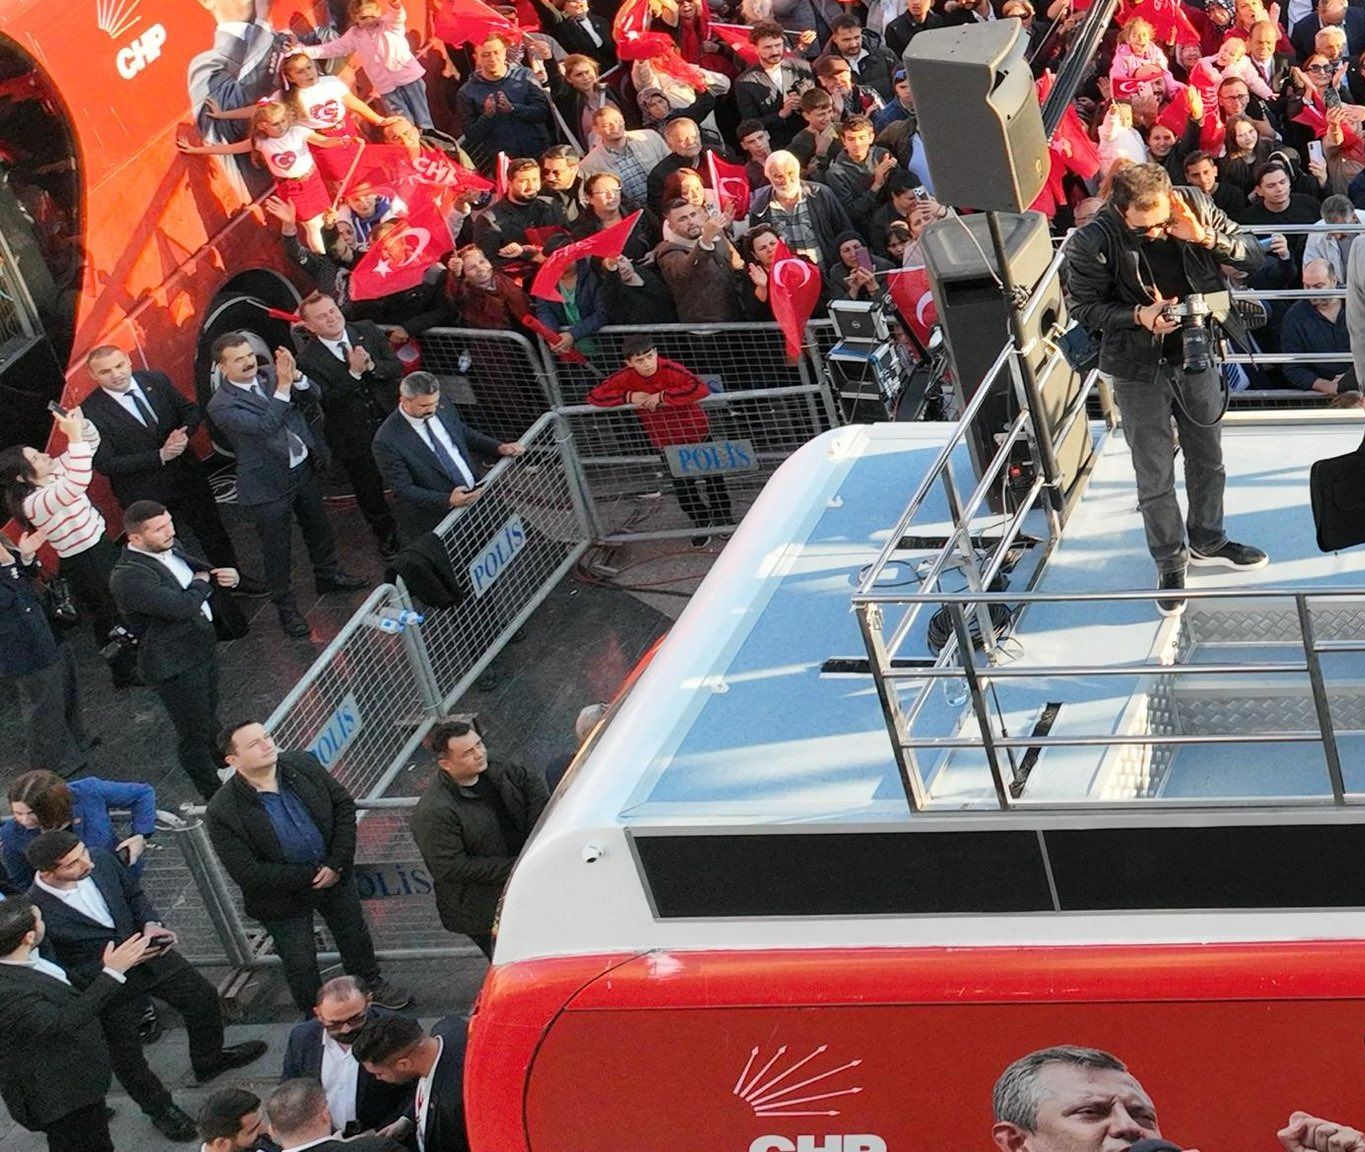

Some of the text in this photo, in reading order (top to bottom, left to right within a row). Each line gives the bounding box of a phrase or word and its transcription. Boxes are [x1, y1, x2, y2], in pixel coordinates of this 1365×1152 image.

[115, 22, 168, 81] CHP
[677, 441, 751, 474] POLİS
[472, 519, 528, 592] POLİS
[313, 703, 357, 766] OLİS
[355, 865, 434, 898] OLİS
